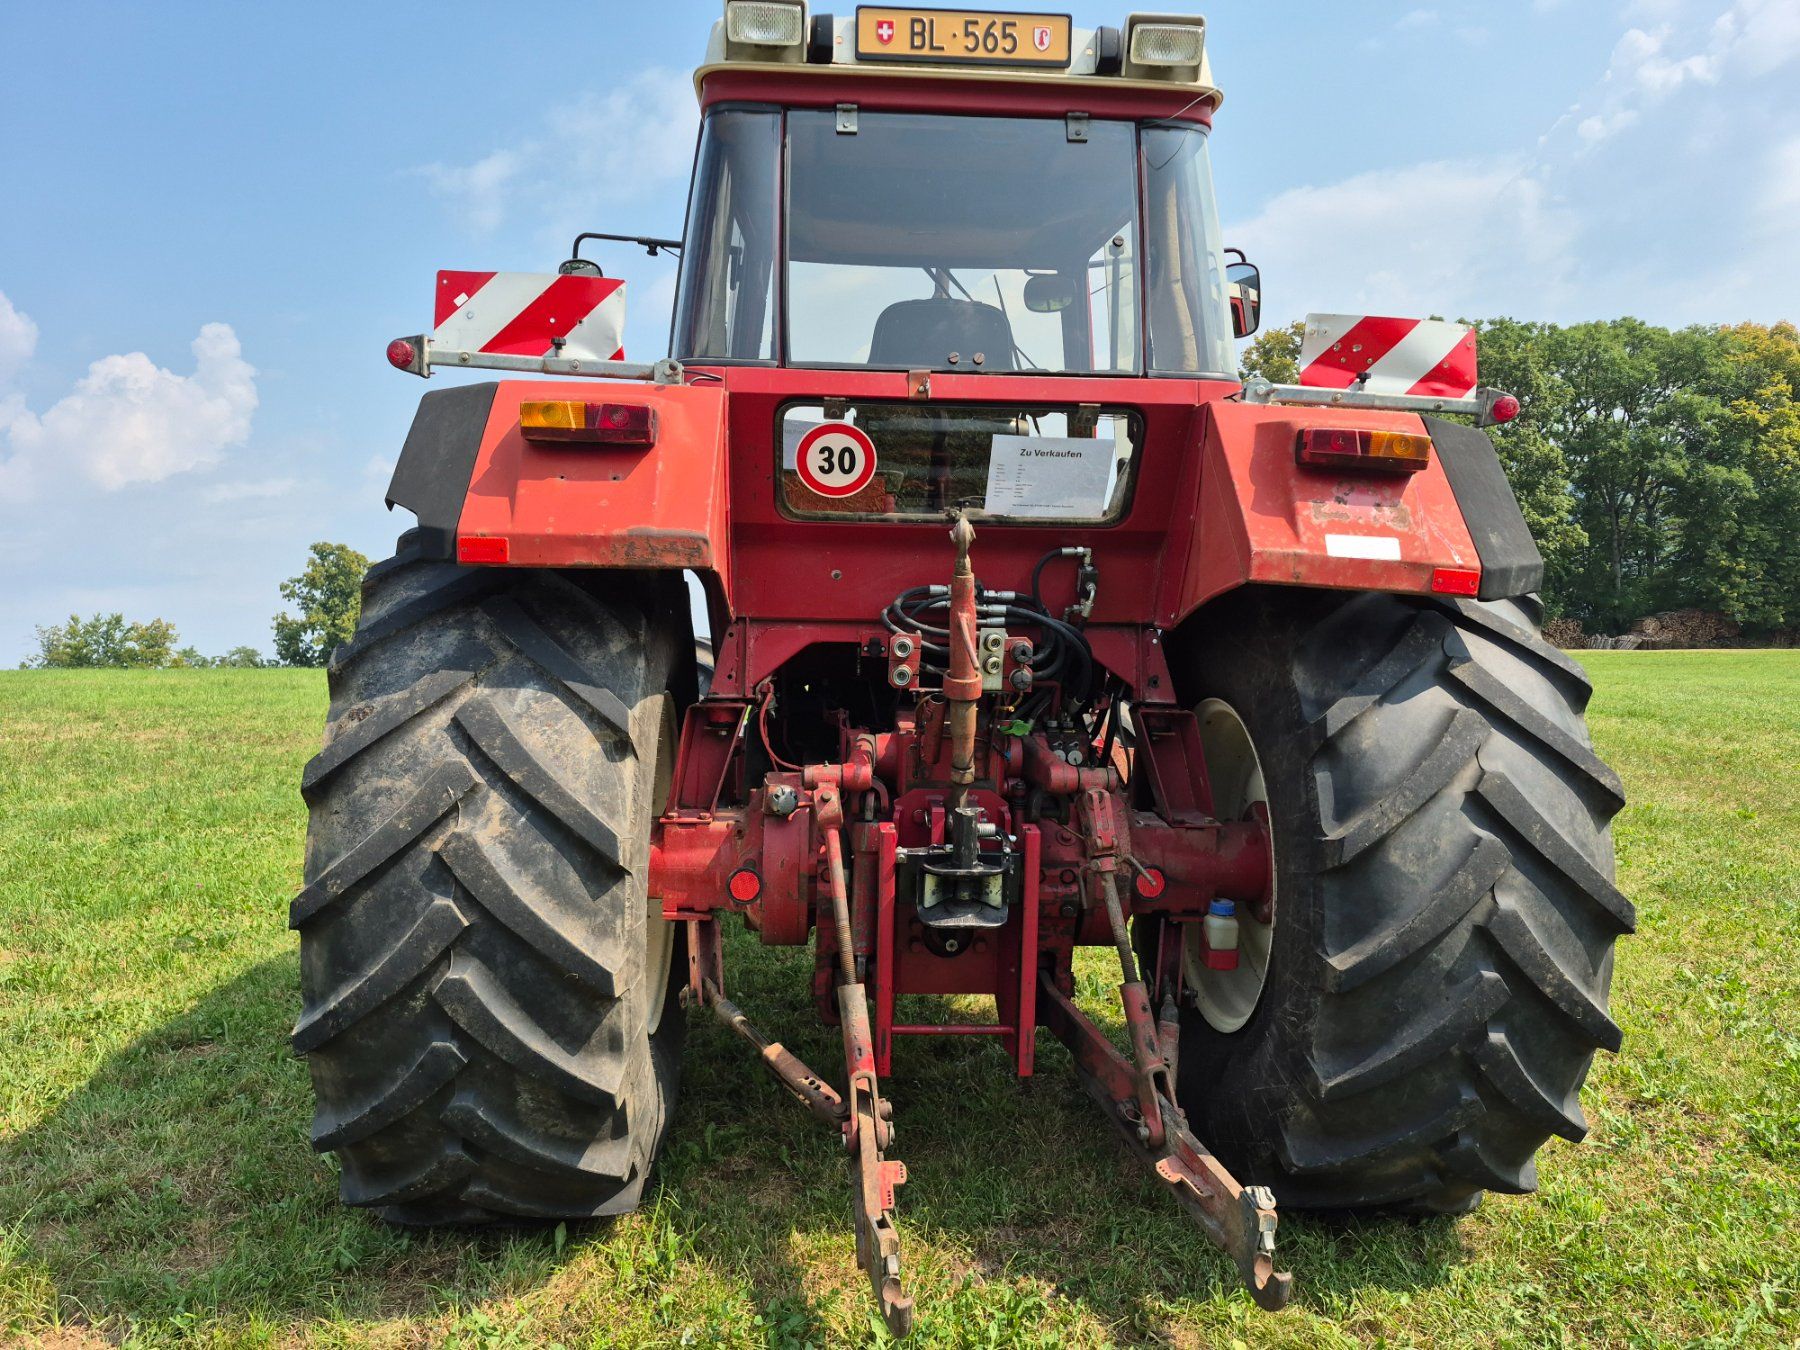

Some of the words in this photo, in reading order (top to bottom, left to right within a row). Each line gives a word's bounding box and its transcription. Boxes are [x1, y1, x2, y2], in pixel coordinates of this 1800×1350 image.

[818, 445, 856, 475] 30
[1020, 448, 1032, 456] Zu
[1034, 449, 1082, 458] Verkaufen
